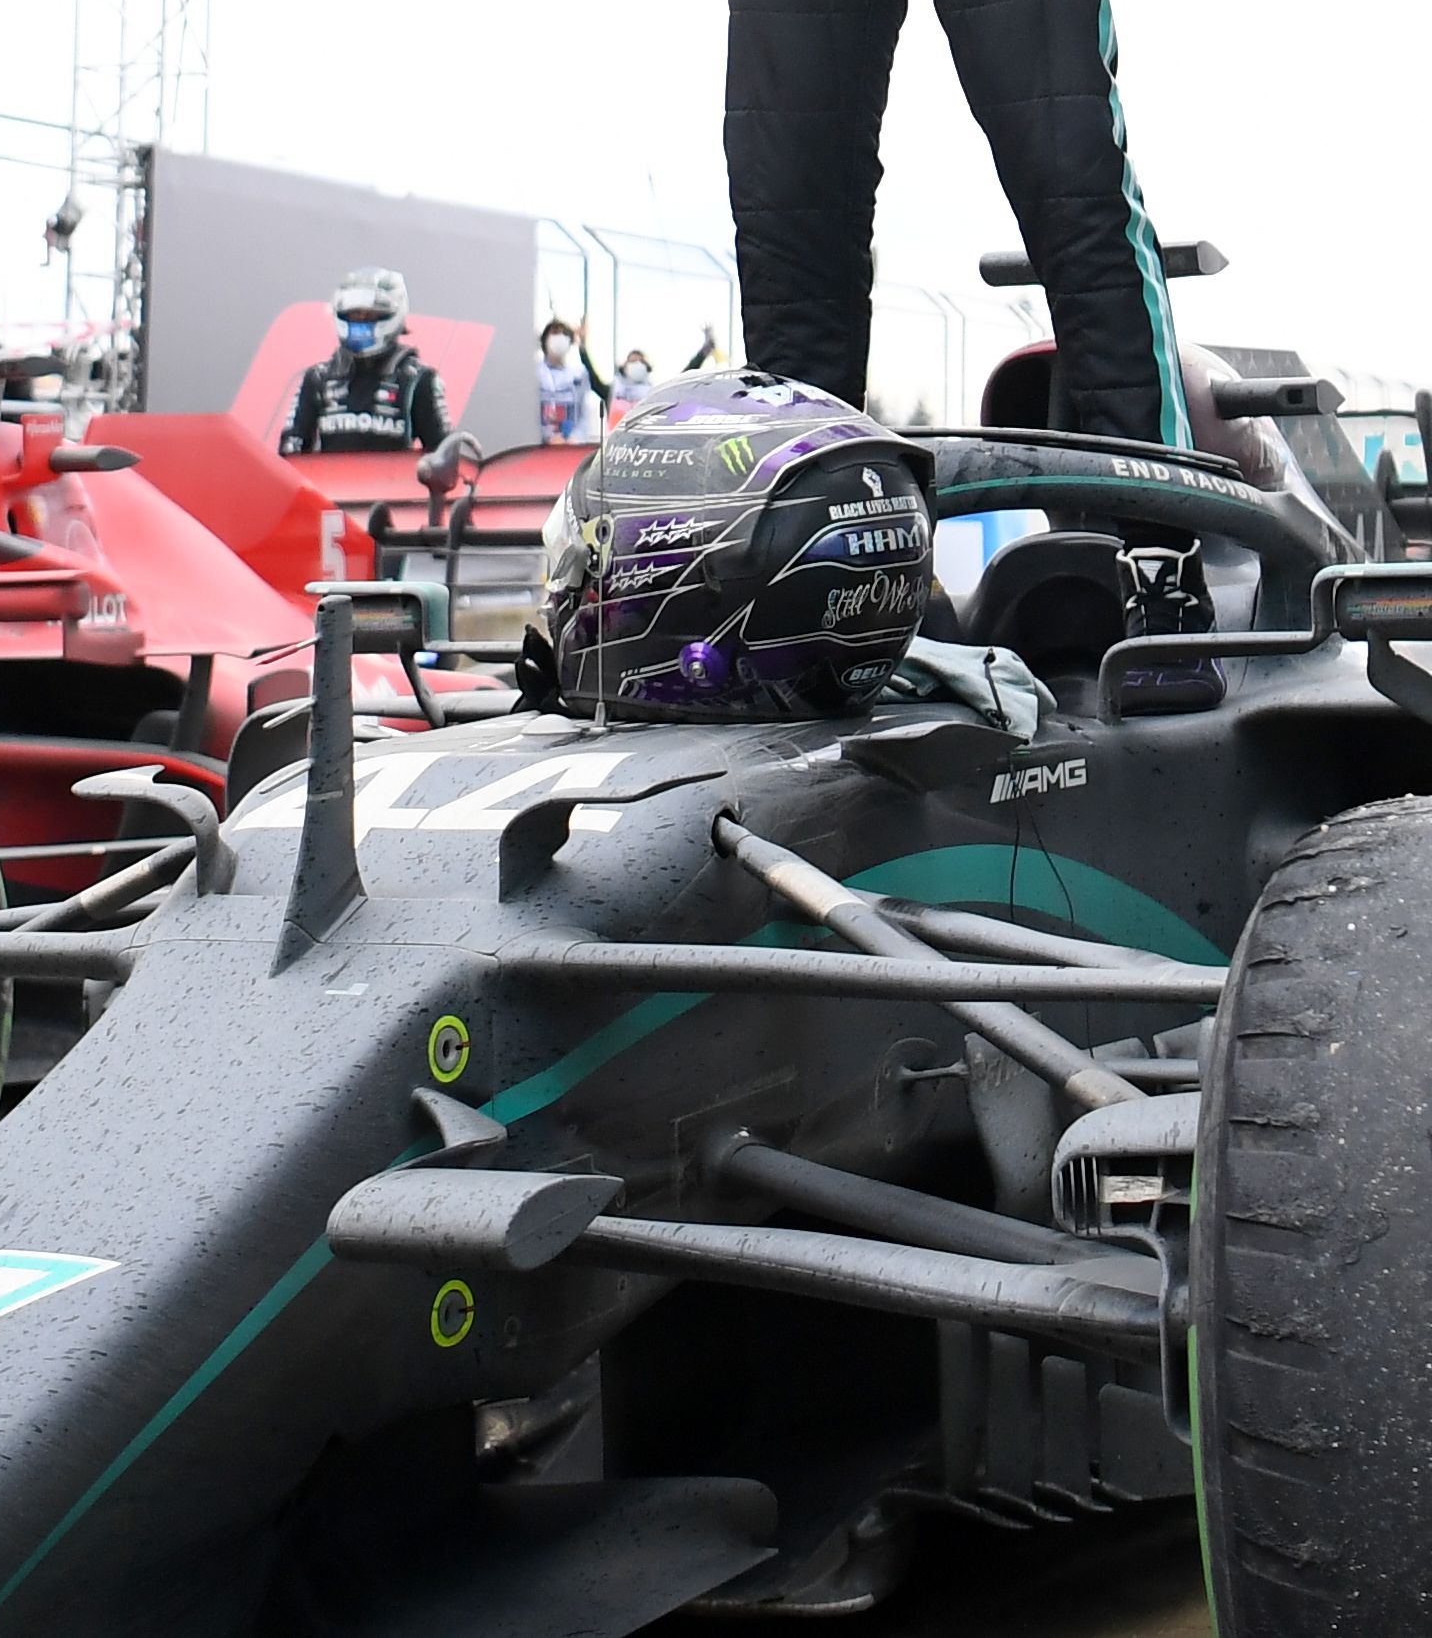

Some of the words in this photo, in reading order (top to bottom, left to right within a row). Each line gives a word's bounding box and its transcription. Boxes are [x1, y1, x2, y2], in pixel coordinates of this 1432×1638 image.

[606, 444, 695, 467] MONSTER
[1110, 457, 1171, 482] END
[1179, 467, 1264, 506] RACISM
[828, 502, 867, 521] BLACK
[866, 498, 893, 514] LIVES
[845, 525, 921, 556] HAM
[848, 664, 887, 682] BELL
